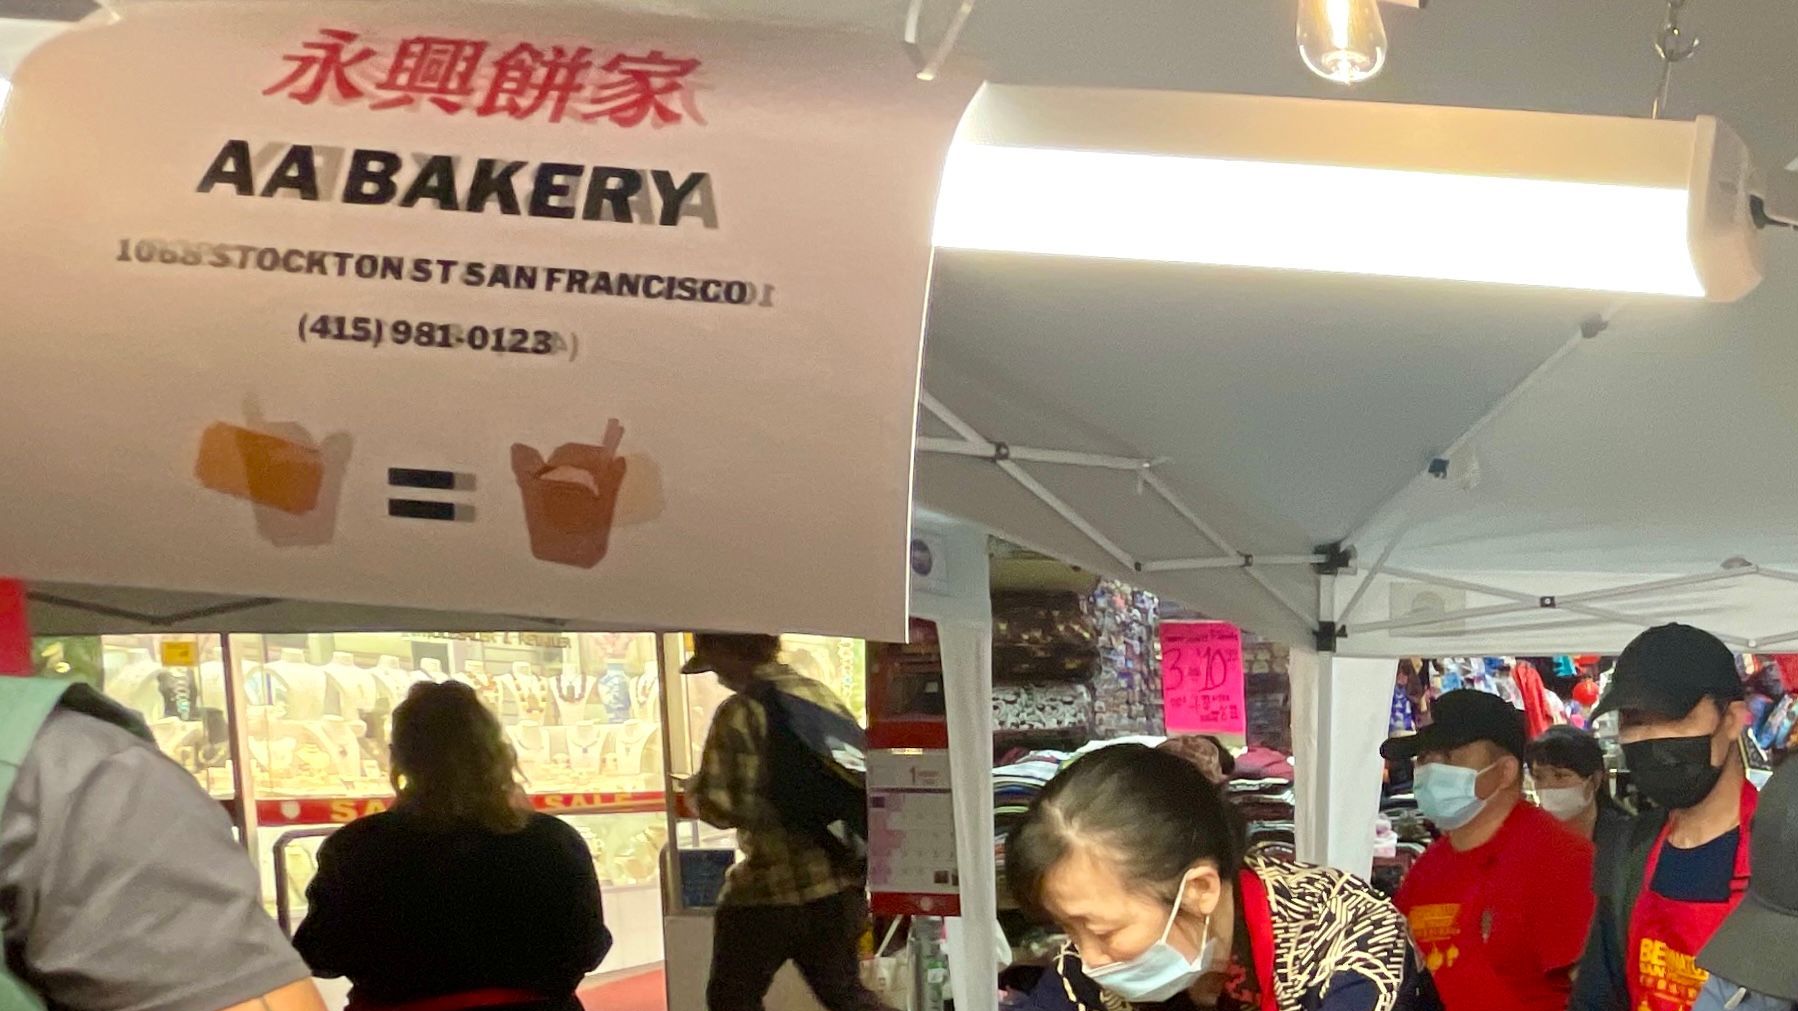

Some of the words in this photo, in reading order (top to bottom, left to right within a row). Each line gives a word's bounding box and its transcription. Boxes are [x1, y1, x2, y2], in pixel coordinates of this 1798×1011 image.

[263, 28, 701, 128] 永興餅家
[197, 139, 319, 201] AA
[341, 148, 704, 227] BAKERY
[208, 243, 405, 281] STOCKTON
[410, 258, 458, 284] ST
[461, 261, 538, 290] SAN
[544, 266, 747, 304] FRANCISCO
[298, 312, 383, 348] (415)
[391, 319, 552, 355] 981-0123
